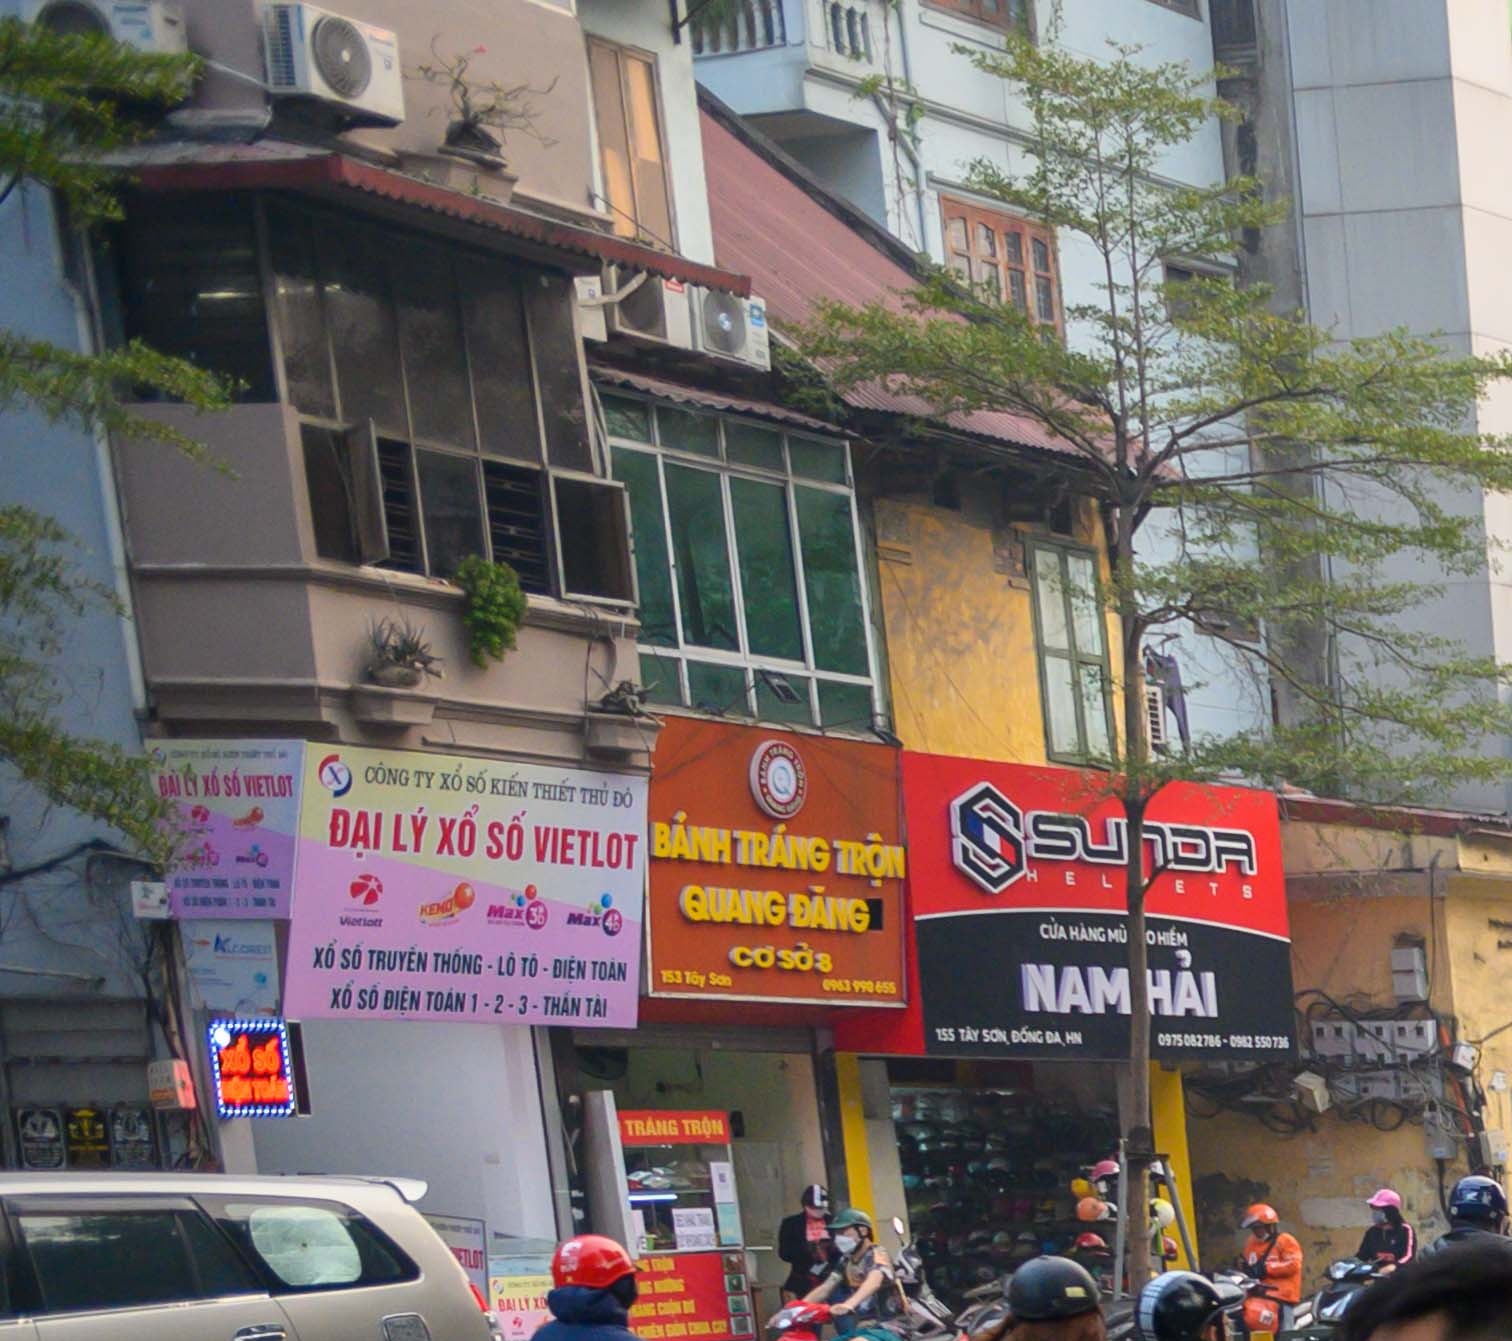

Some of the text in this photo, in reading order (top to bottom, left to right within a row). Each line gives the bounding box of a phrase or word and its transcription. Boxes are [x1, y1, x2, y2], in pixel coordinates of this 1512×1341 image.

[243, 775, 293, 798] VIETLOT
[365, 761, 411, 788] CÔNG
[415, 771, 435, 789] TY
[466, 770, 487, 794] SỐ
[490, 771, 528, 798] KIẾN
[533, 778, 577, 803] THIẾT
[329, 804, 639, 870] ĐẠI LÝ XỔ SỐ VIETLOT
[651, 810, 907, 887] BÁNH TRÁNG TRỘN
[1025, 871, 1253, 899] HELETS
[680, 885, 786, 927] QUANG
[1070, 921, 1105, 943] HÀNG
[1021, 949, 1219, 1018] NAM HẢI
[935, 1028, 955, 1043] 155
[959, 1026, 980, 1043] TÂY
[625, 1116, 679, 1137] TRÁNG
